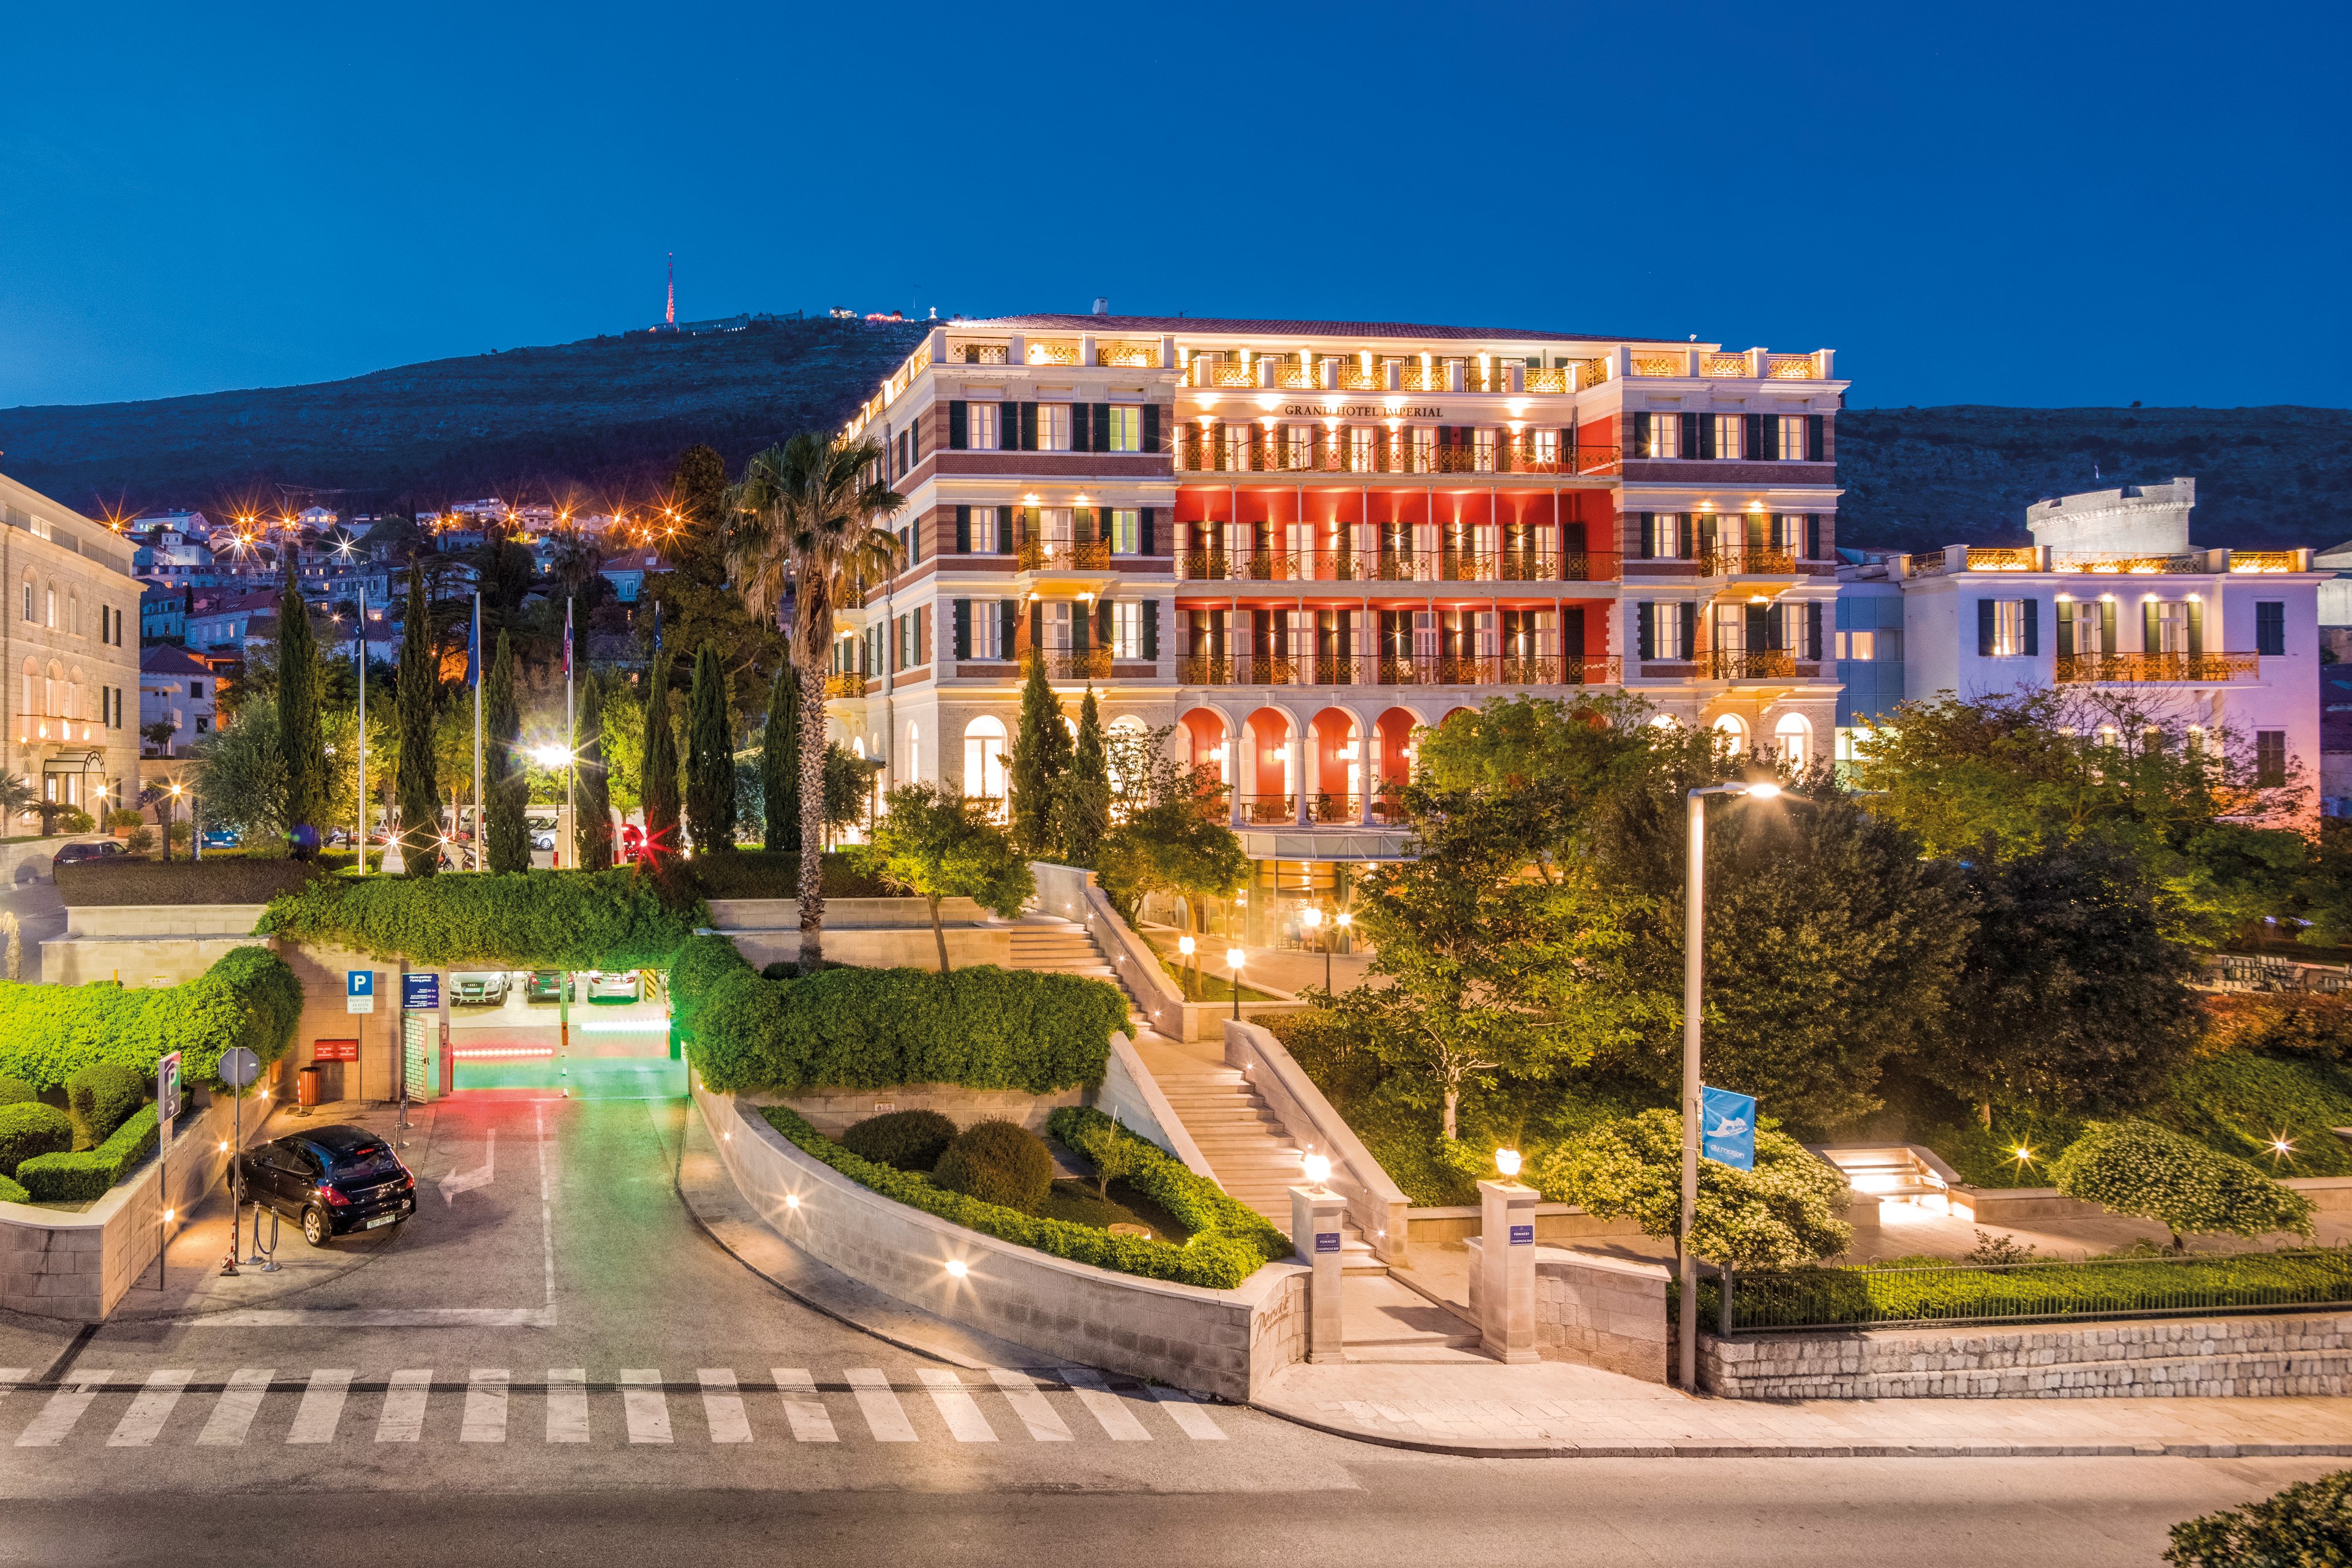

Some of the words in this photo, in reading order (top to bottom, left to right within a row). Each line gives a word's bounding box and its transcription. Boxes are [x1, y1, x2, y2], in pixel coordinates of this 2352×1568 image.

[1285, 405, 1332, 416] GRAND
[1337, 406, 1379, 417] HOTEL
[1382, 407, 1444, 418] IMPERIAL
[354, 975, 366, 992] P
[168, 1068, 176, 1096] P
